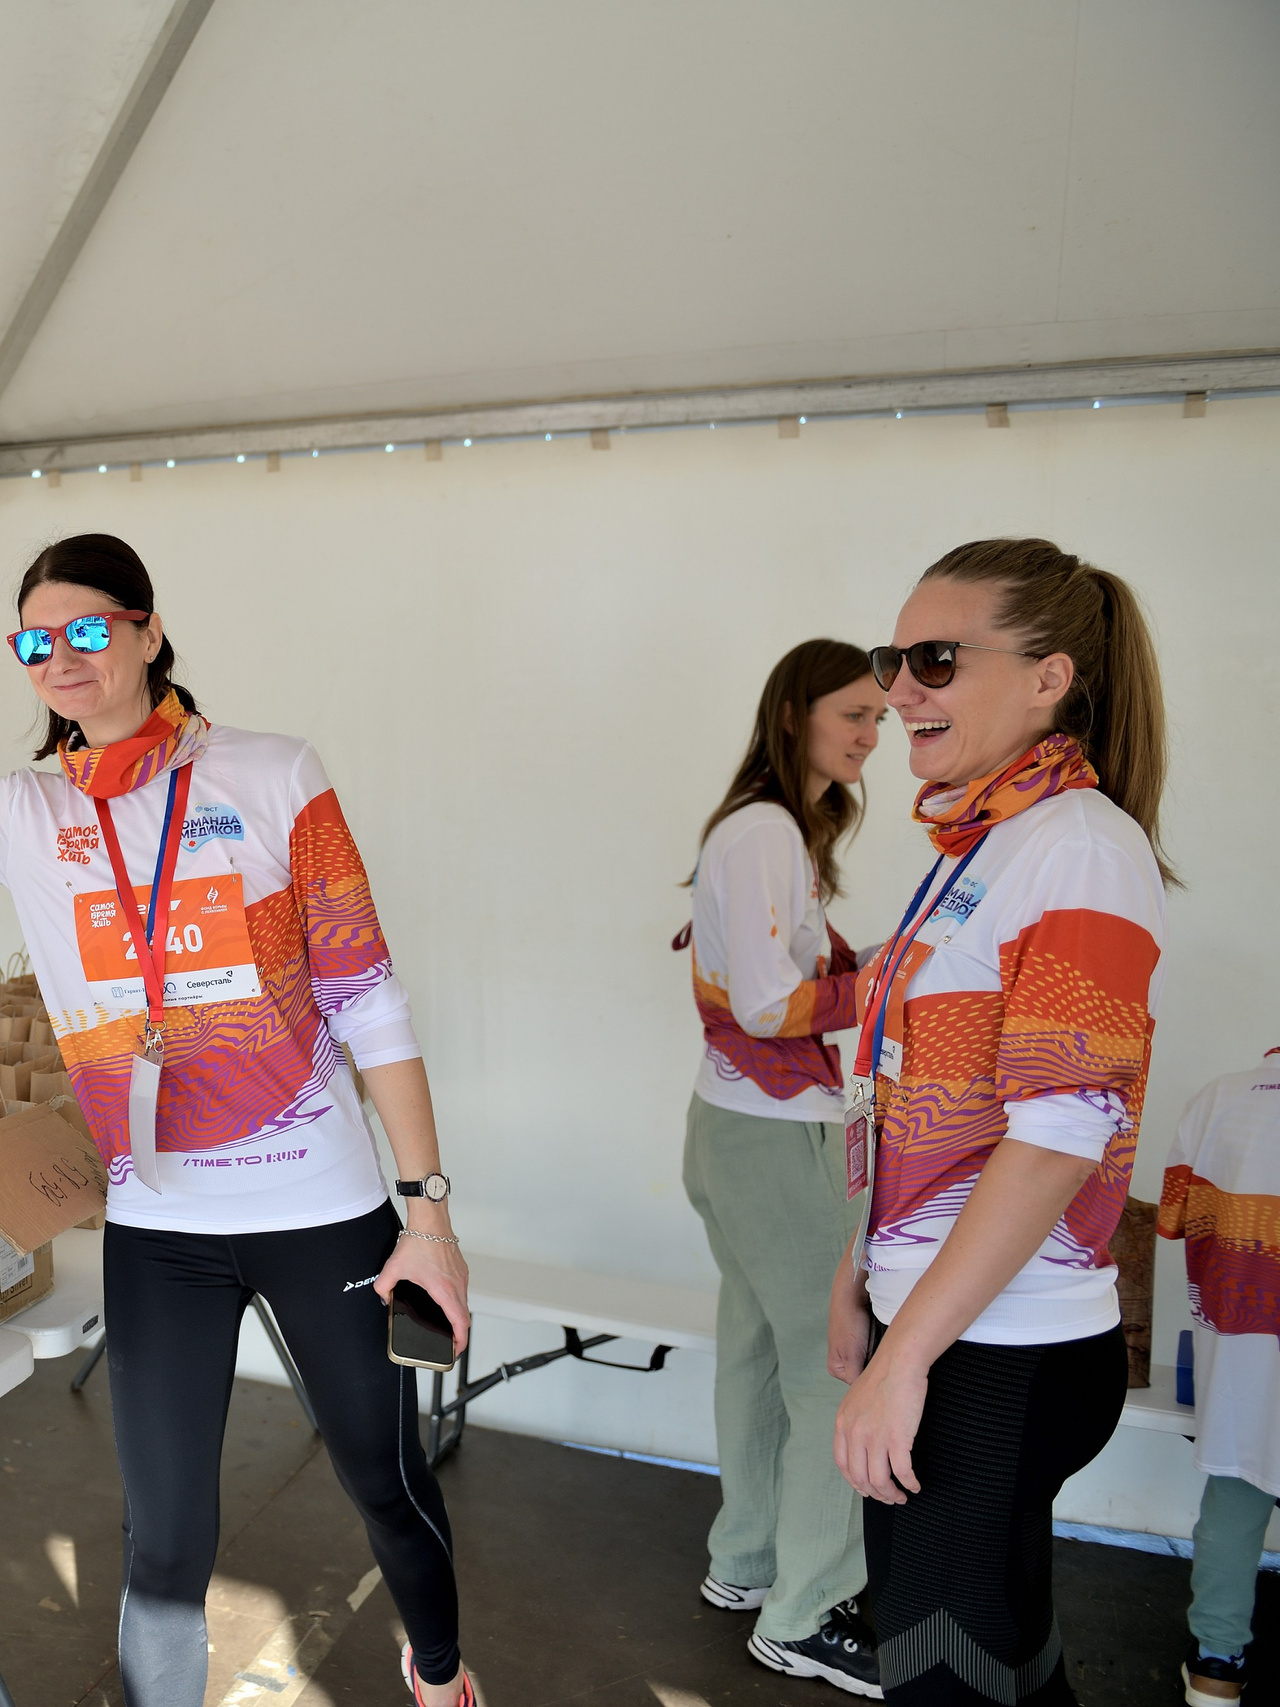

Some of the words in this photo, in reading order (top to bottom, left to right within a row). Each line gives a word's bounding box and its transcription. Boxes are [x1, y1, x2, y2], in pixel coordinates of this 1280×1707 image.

[182, 815, 240, 830] ОМАНДА
[122, 924, 203, 960] 240
[186, 977, 232, 989] Северсталь
[235, 1155, 262, 1166] TO
